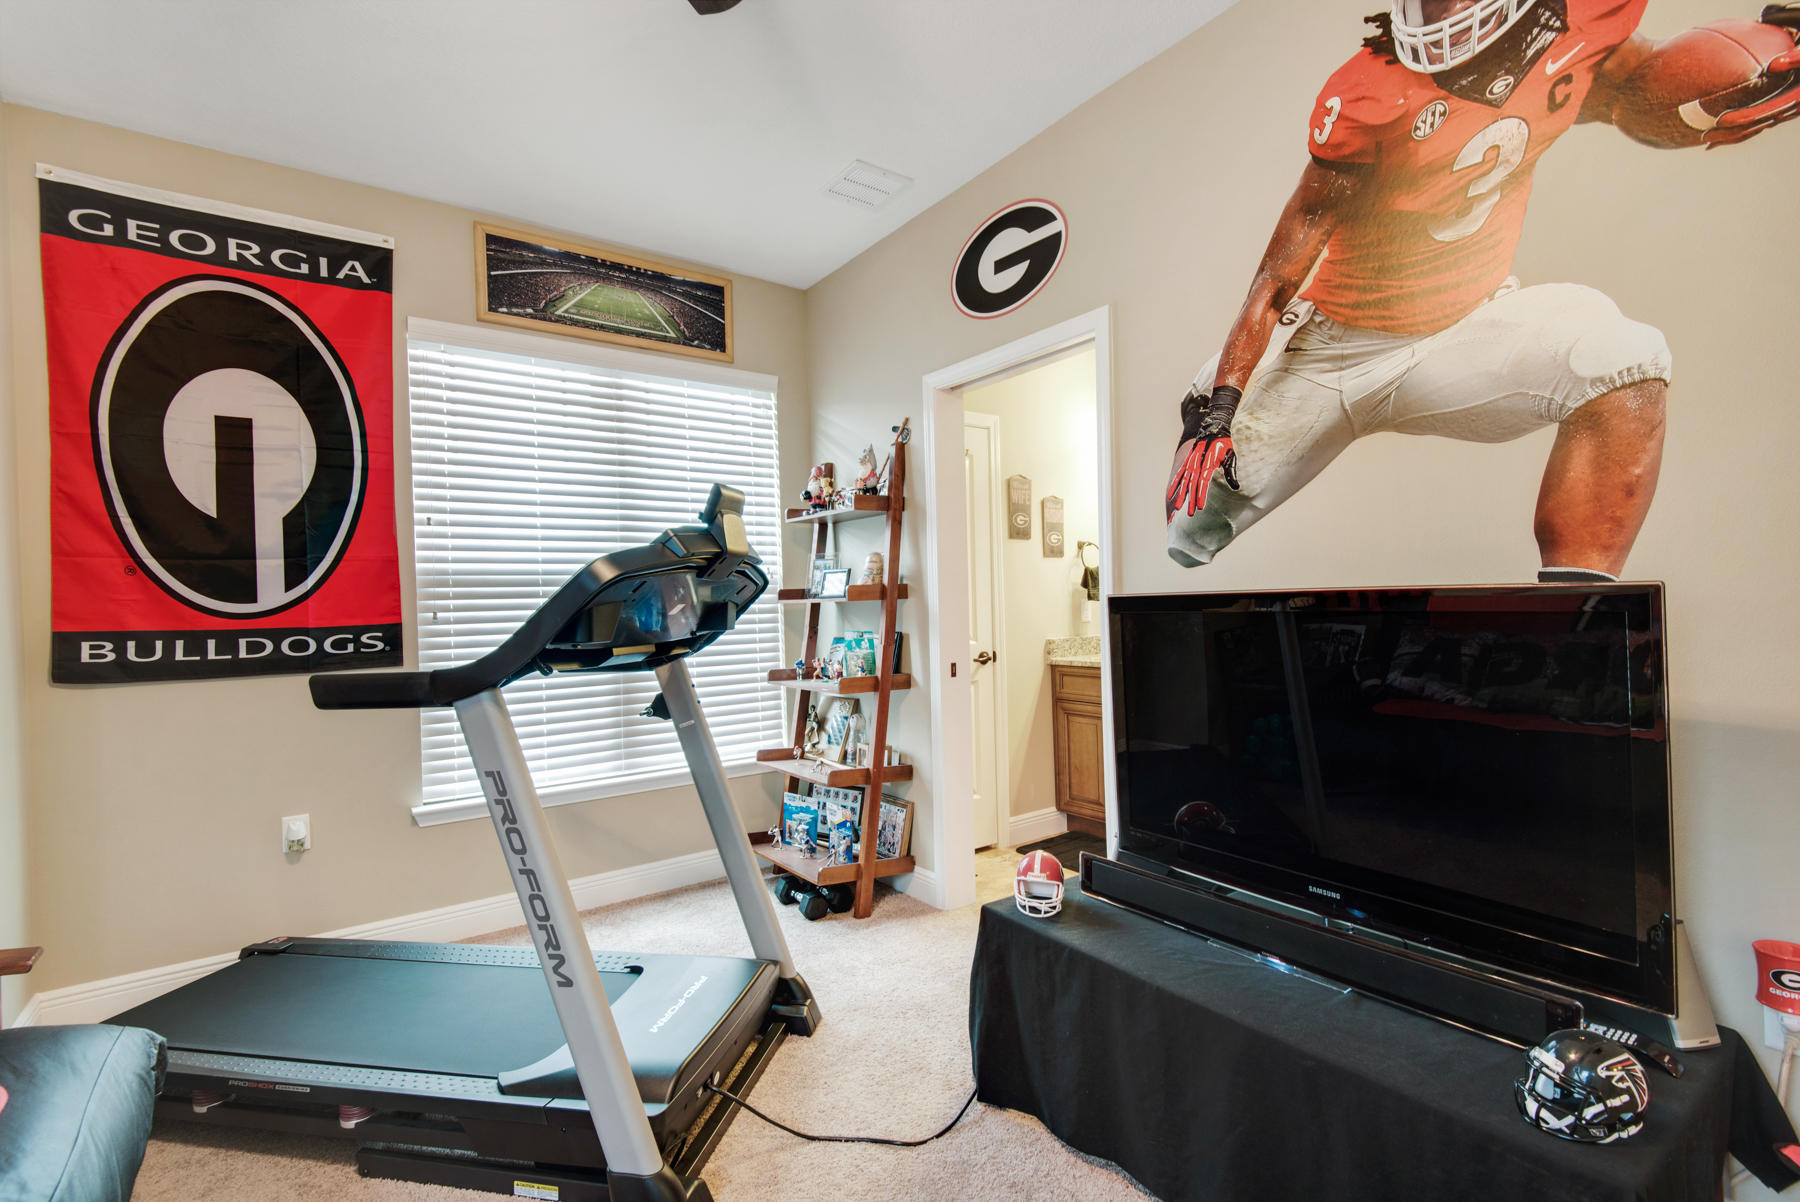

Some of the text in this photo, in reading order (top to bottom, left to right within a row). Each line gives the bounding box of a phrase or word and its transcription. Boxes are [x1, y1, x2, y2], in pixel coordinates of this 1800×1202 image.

[1313, 96, 1341, 145] 3
[1413, 102, 1448, 139] SEC
[1547, 72, 1573, 112] C
[1427, 116, 1530, 242] 3
[67, 208, 372, 284] GEORGIA
[953, 200, 1066, 317] G
[484, 770, 574, 988] PRO-FORM
[1308, 885, 1341, 900] SAMSUNG
[650, 975, 708, 1033] PRO-FORM
